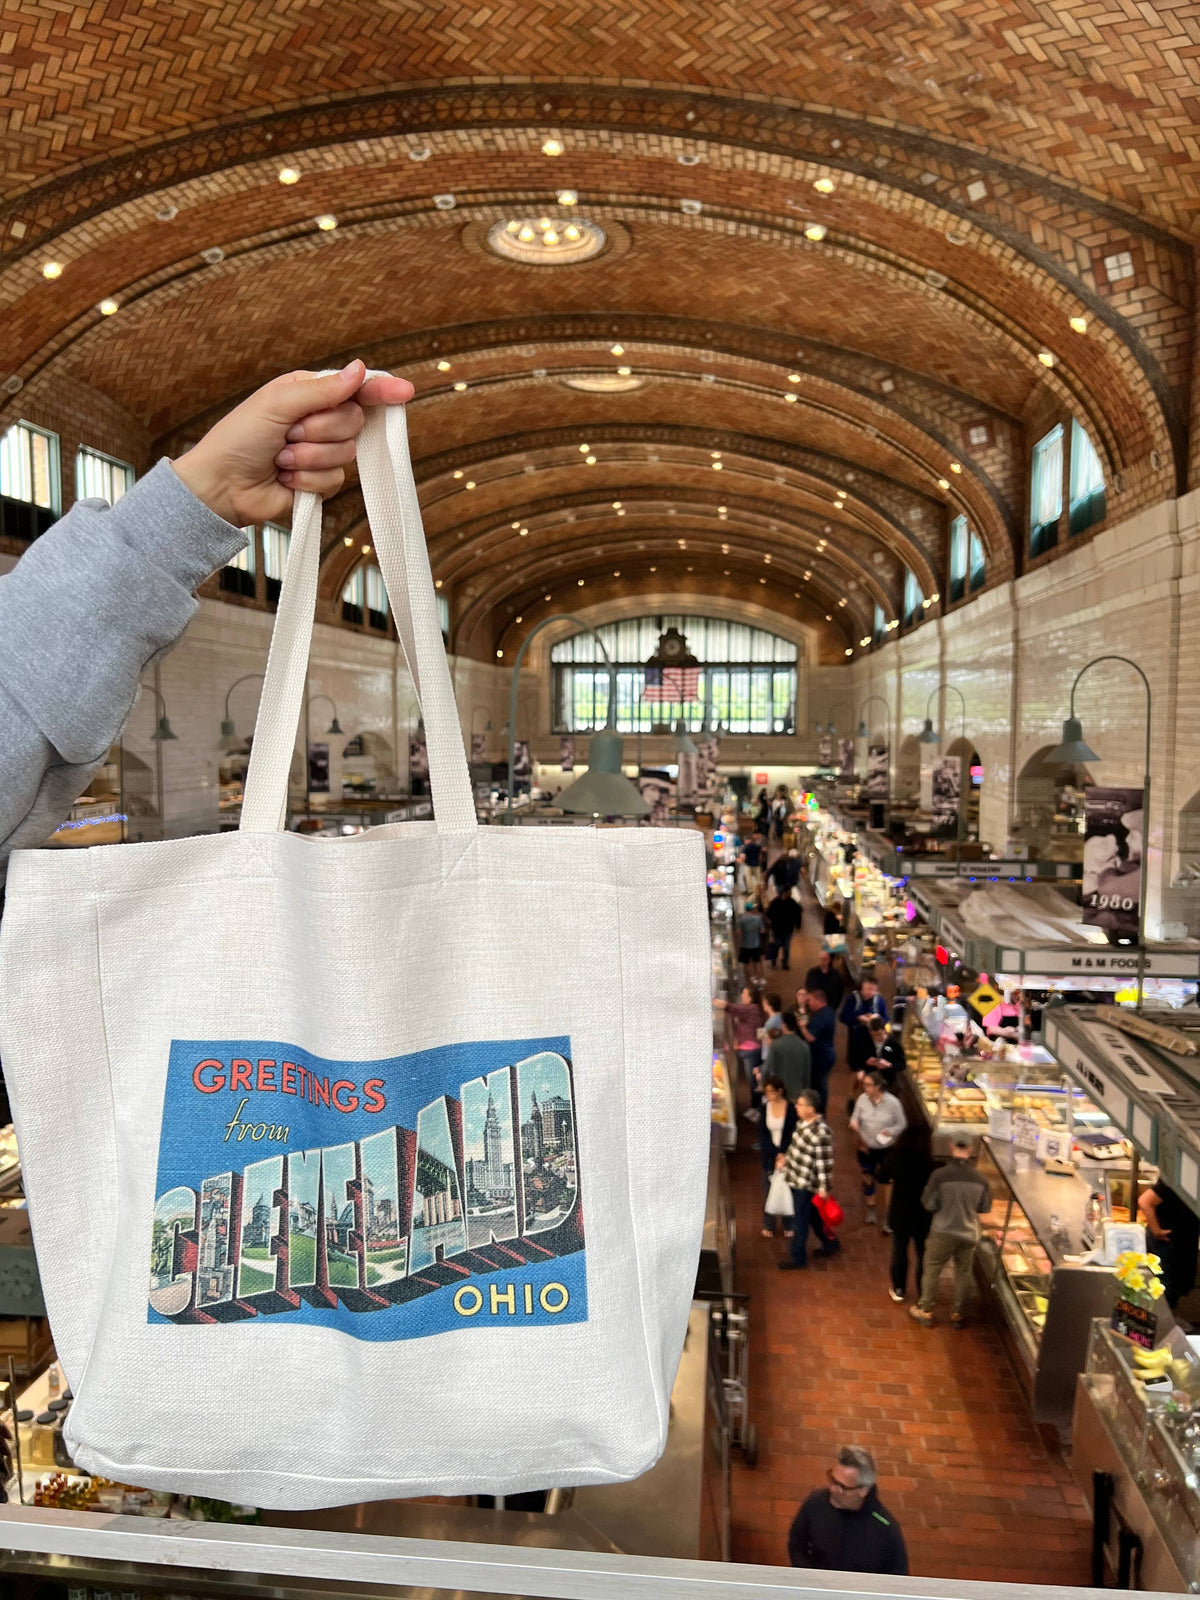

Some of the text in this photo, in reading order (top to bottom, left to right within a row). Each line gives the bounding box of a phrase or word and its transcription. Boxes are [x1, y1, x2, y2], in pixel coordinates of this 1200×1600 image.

[1090, 894, 1133, 911] 1980
[1072, 957, 1152, 969] M & M FOOS
[192, 1058, 387, 1115] GREETINGS
[222, 1097, 291, 1144] from
[148, 1050, 583, 1321] CLEVELAND
[453, 1281, 570, 1316] OHIO
